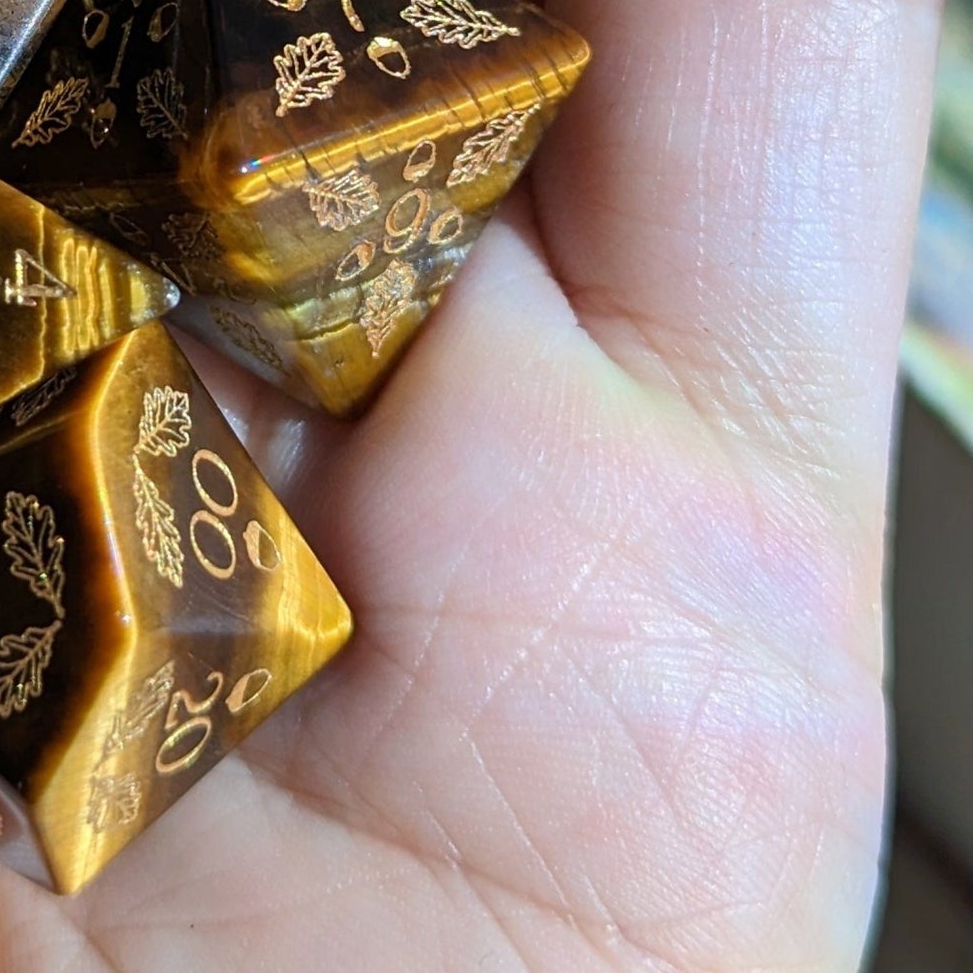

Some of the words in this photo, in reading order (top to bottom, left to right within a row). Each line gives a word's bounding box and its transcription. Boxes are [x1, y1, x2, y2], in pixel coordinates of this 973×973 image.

[4, 248, 77, 307] 4
[189, 448, 239, 581] 00
[155, 671, 224, 775] 20
